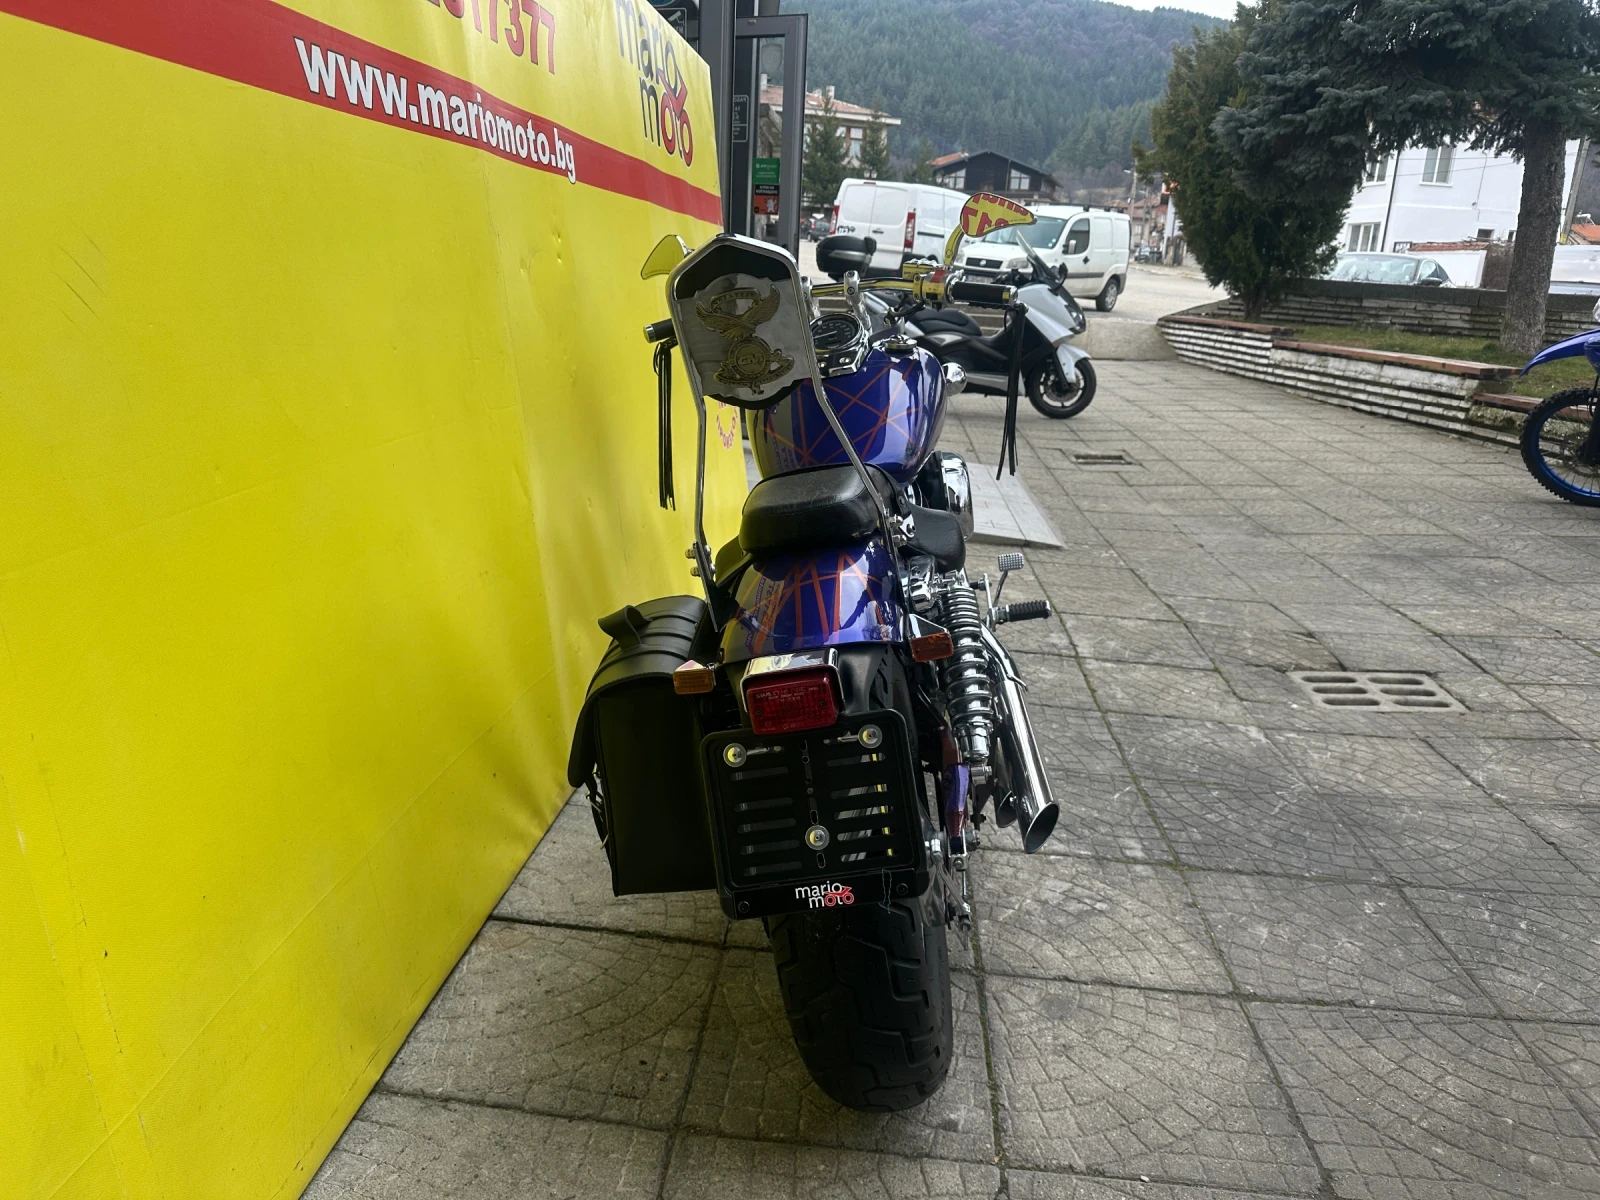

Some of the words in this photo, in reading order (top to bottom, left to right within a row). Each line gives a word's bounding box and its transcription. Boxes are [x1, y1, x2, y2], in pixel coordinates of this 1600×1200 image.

[294, 37, 577, 185] www.mariomoto.bg
[795, 880, 843, 899] mario
[809, 893, 855, 909] moto
